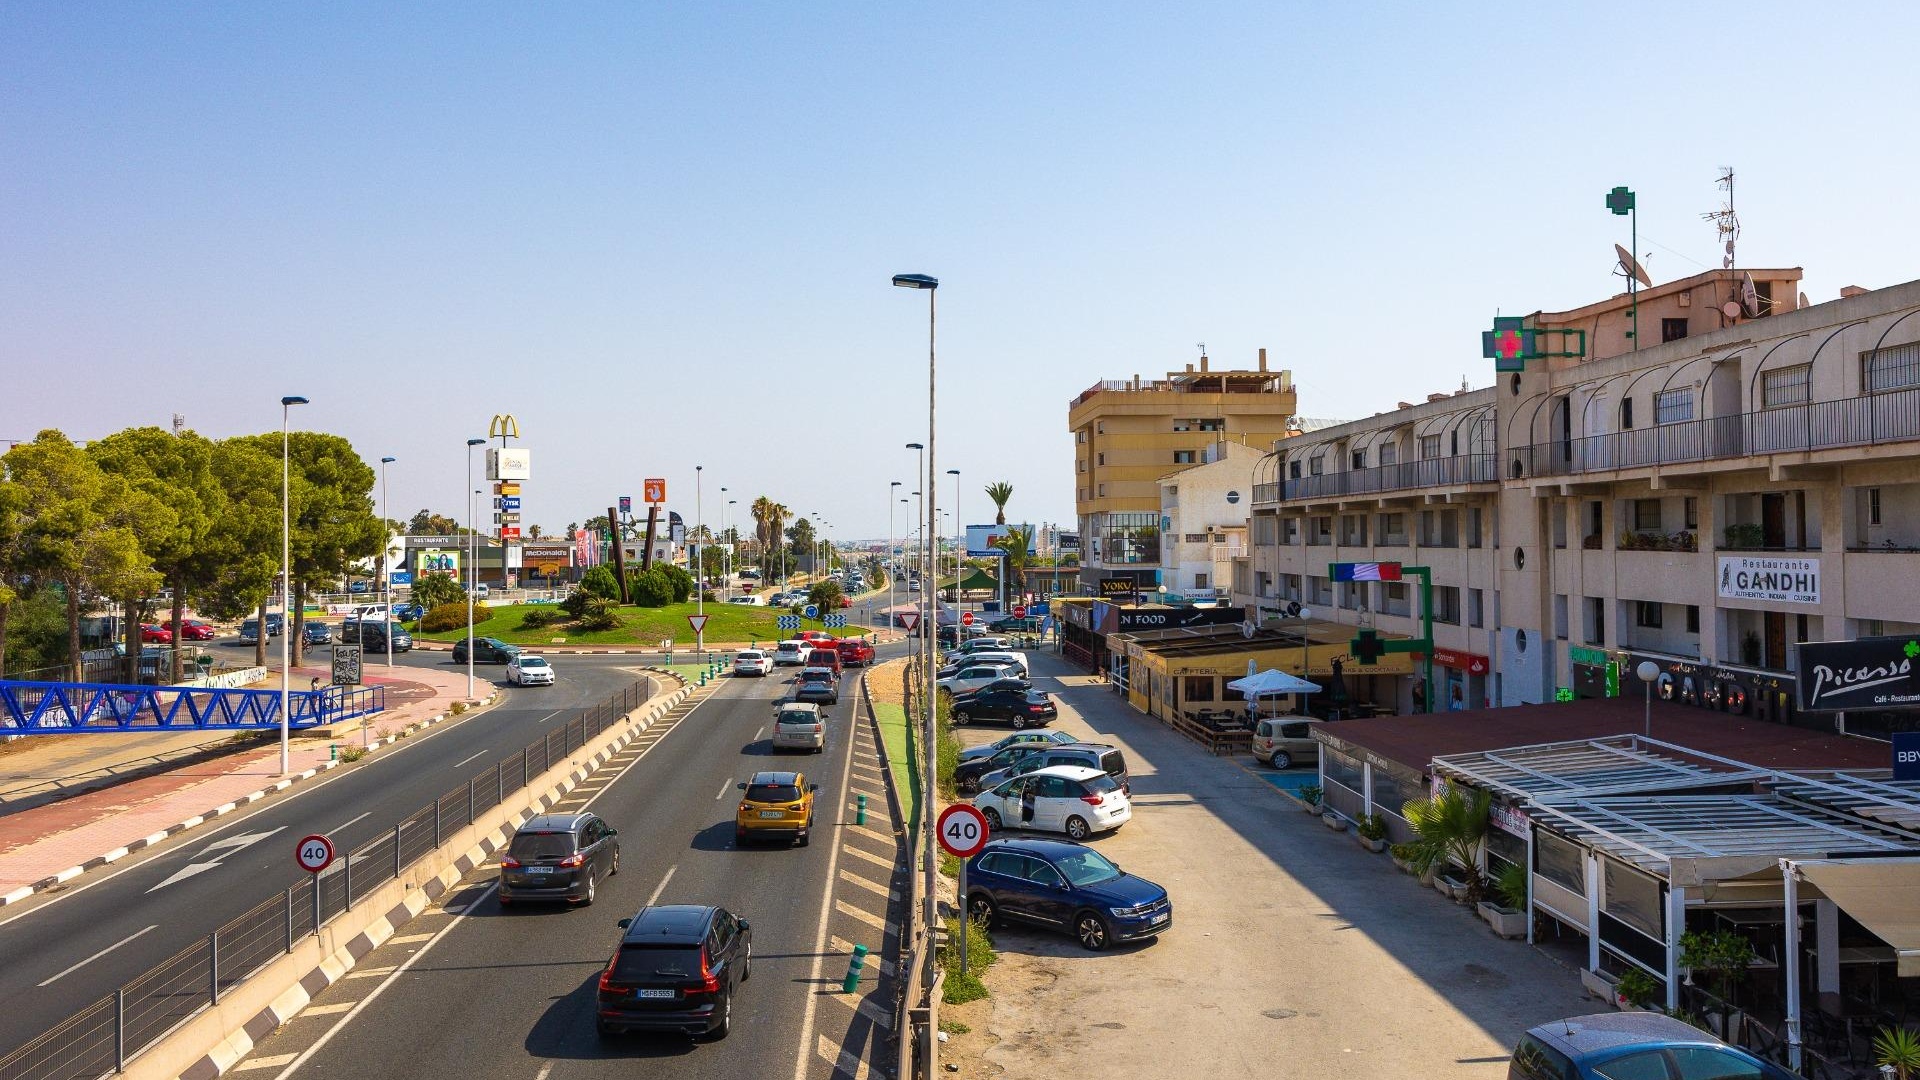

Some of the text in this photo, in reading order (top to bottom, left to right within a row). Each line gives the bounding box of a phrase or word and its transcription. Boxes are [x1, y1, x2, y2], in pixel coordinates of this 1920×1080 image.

[1742, 559, 1810, 570] Restaurante
[1103, 581, 1132, 591] YOKU
[1736, 571, 1816, 593] GANDHI
[1735, 591, 1765, 599] AUTHENTIC
[1136, 615, 1166, 624] FOOD
[1812, 658, 1911, 706] Picasso
[1874, 694, 1887, 703] Café
[1890, 693, 1920, 702] Restaurant
[947, 822, 977, 840] 40
[303, 847, 325, 860] 40
